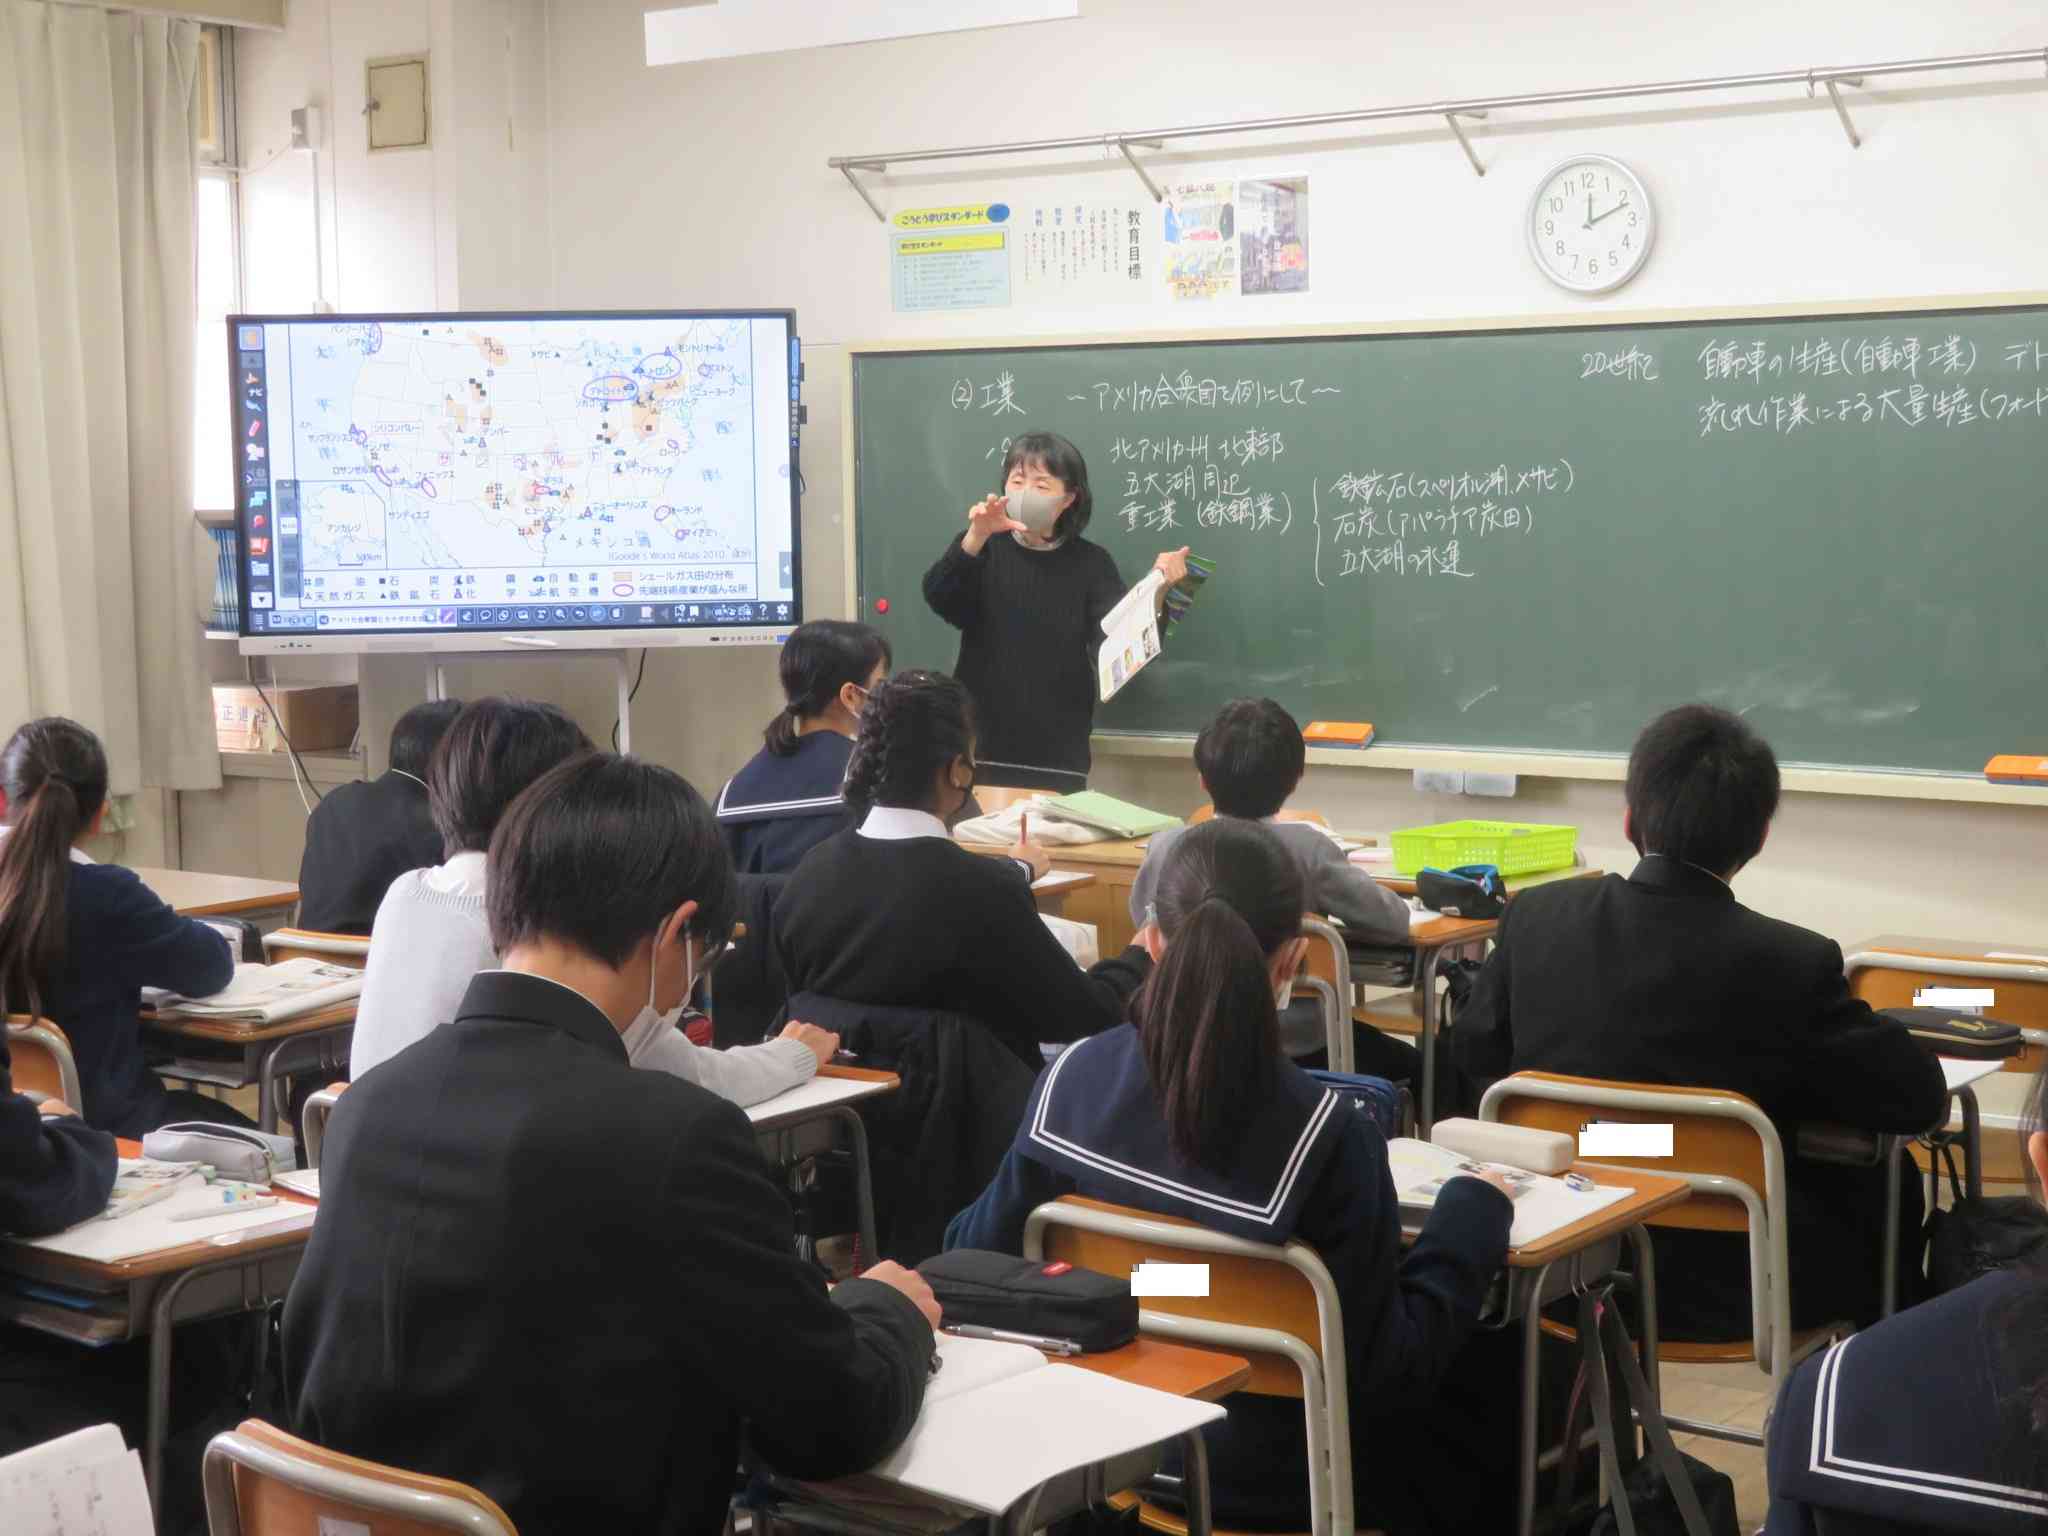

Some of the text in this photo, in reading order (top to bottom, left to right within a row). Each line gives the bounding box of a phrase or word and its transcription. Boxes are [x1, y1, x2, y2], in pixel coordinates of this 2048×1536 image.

[1581, 172, 1595, 189] 12
[1605, 176, 1610, 192] 1
[1564, 181, 1575, 196] 11
[1619, 190, 1629, 205] 2
[1550, 198, 1563, 213] 10
[1628, 212, 1637, 227] 3
[1545, 221, 1554, 235] 9
[1128, 209, 1142, 281] 教育目標
[1556, 240, 1565, 255] 8
[1622, 234, 1630, 248] 4
[1570, 254, 1579, 270] 7
[1608, 251, 1618, 266] 5
[1588, 259, 1598, 274] 6
